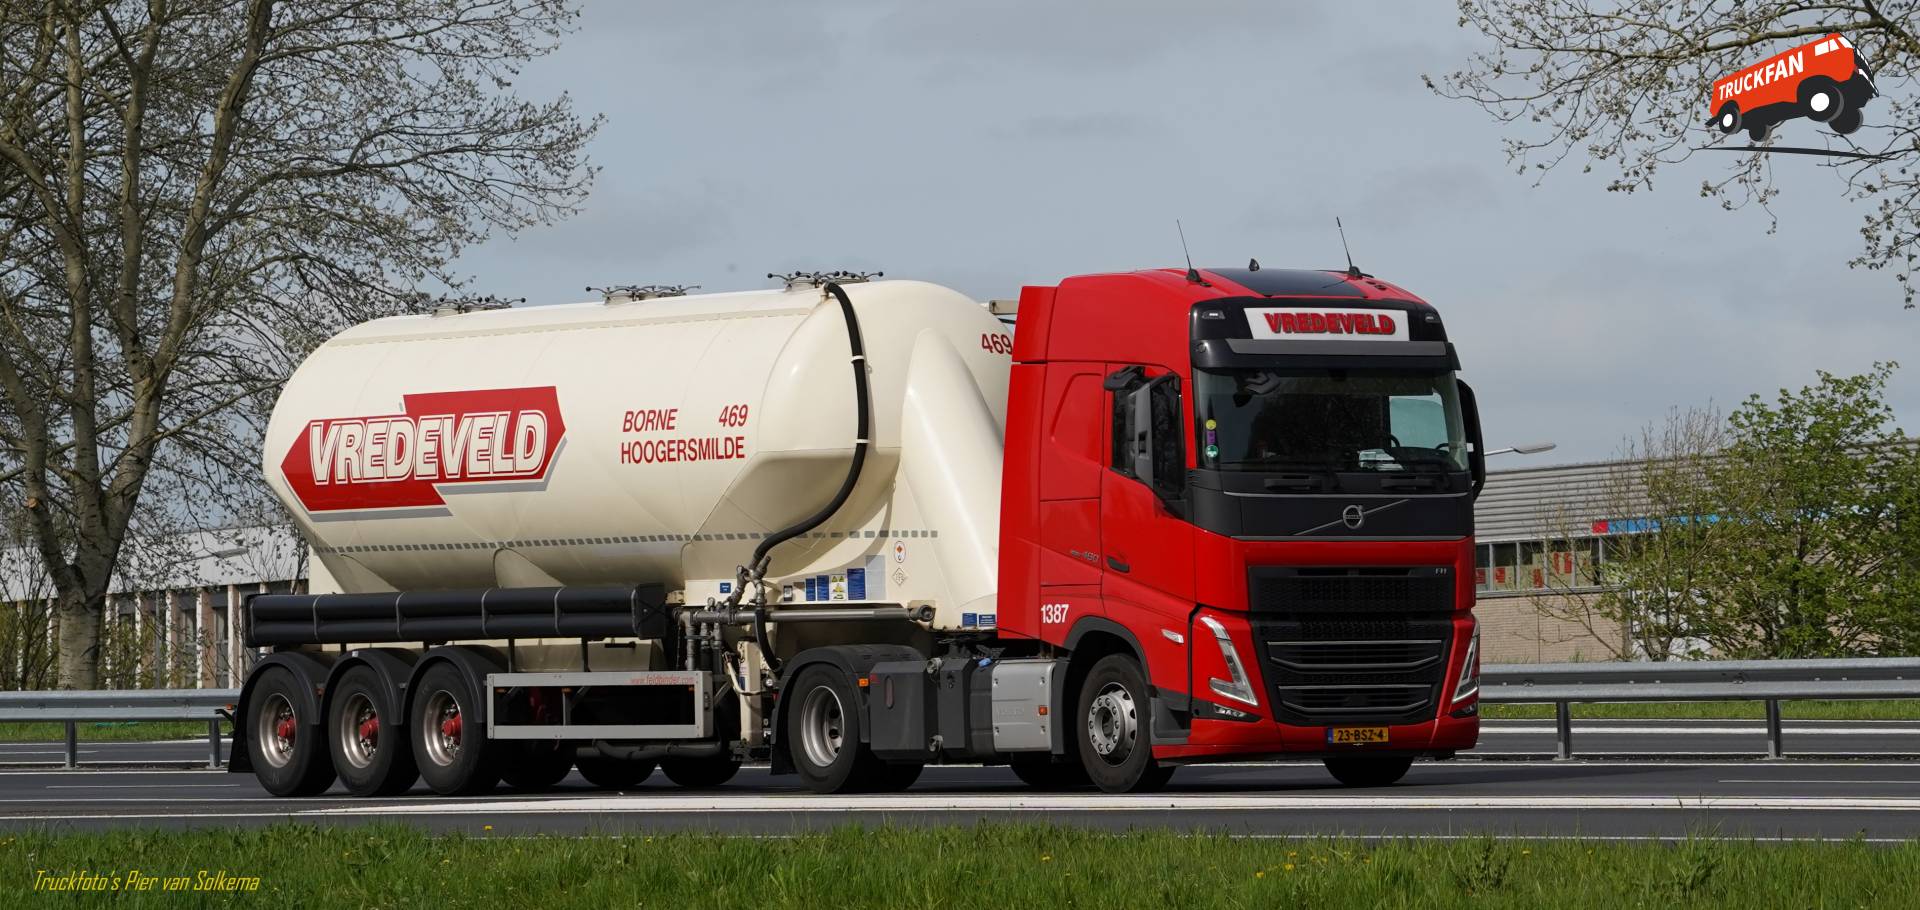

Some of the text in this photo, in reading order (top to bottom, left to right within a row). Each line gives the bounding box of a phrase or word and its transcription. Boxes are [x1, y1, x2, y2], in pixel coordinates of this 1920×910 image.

[1263, 312, 1396, 335] VREDEVELD
[981, 333, 1012, 355] 469
[622, 404, 748, 433] BORNE 469
[309, 409, 548, 486] VREDEVELD
[620, 436, 746, 464] HOOGERSMILDE
[1040, 603, 1069, 624] 1387
[1337, 729, 1384, 742] 23-BSZ-4
